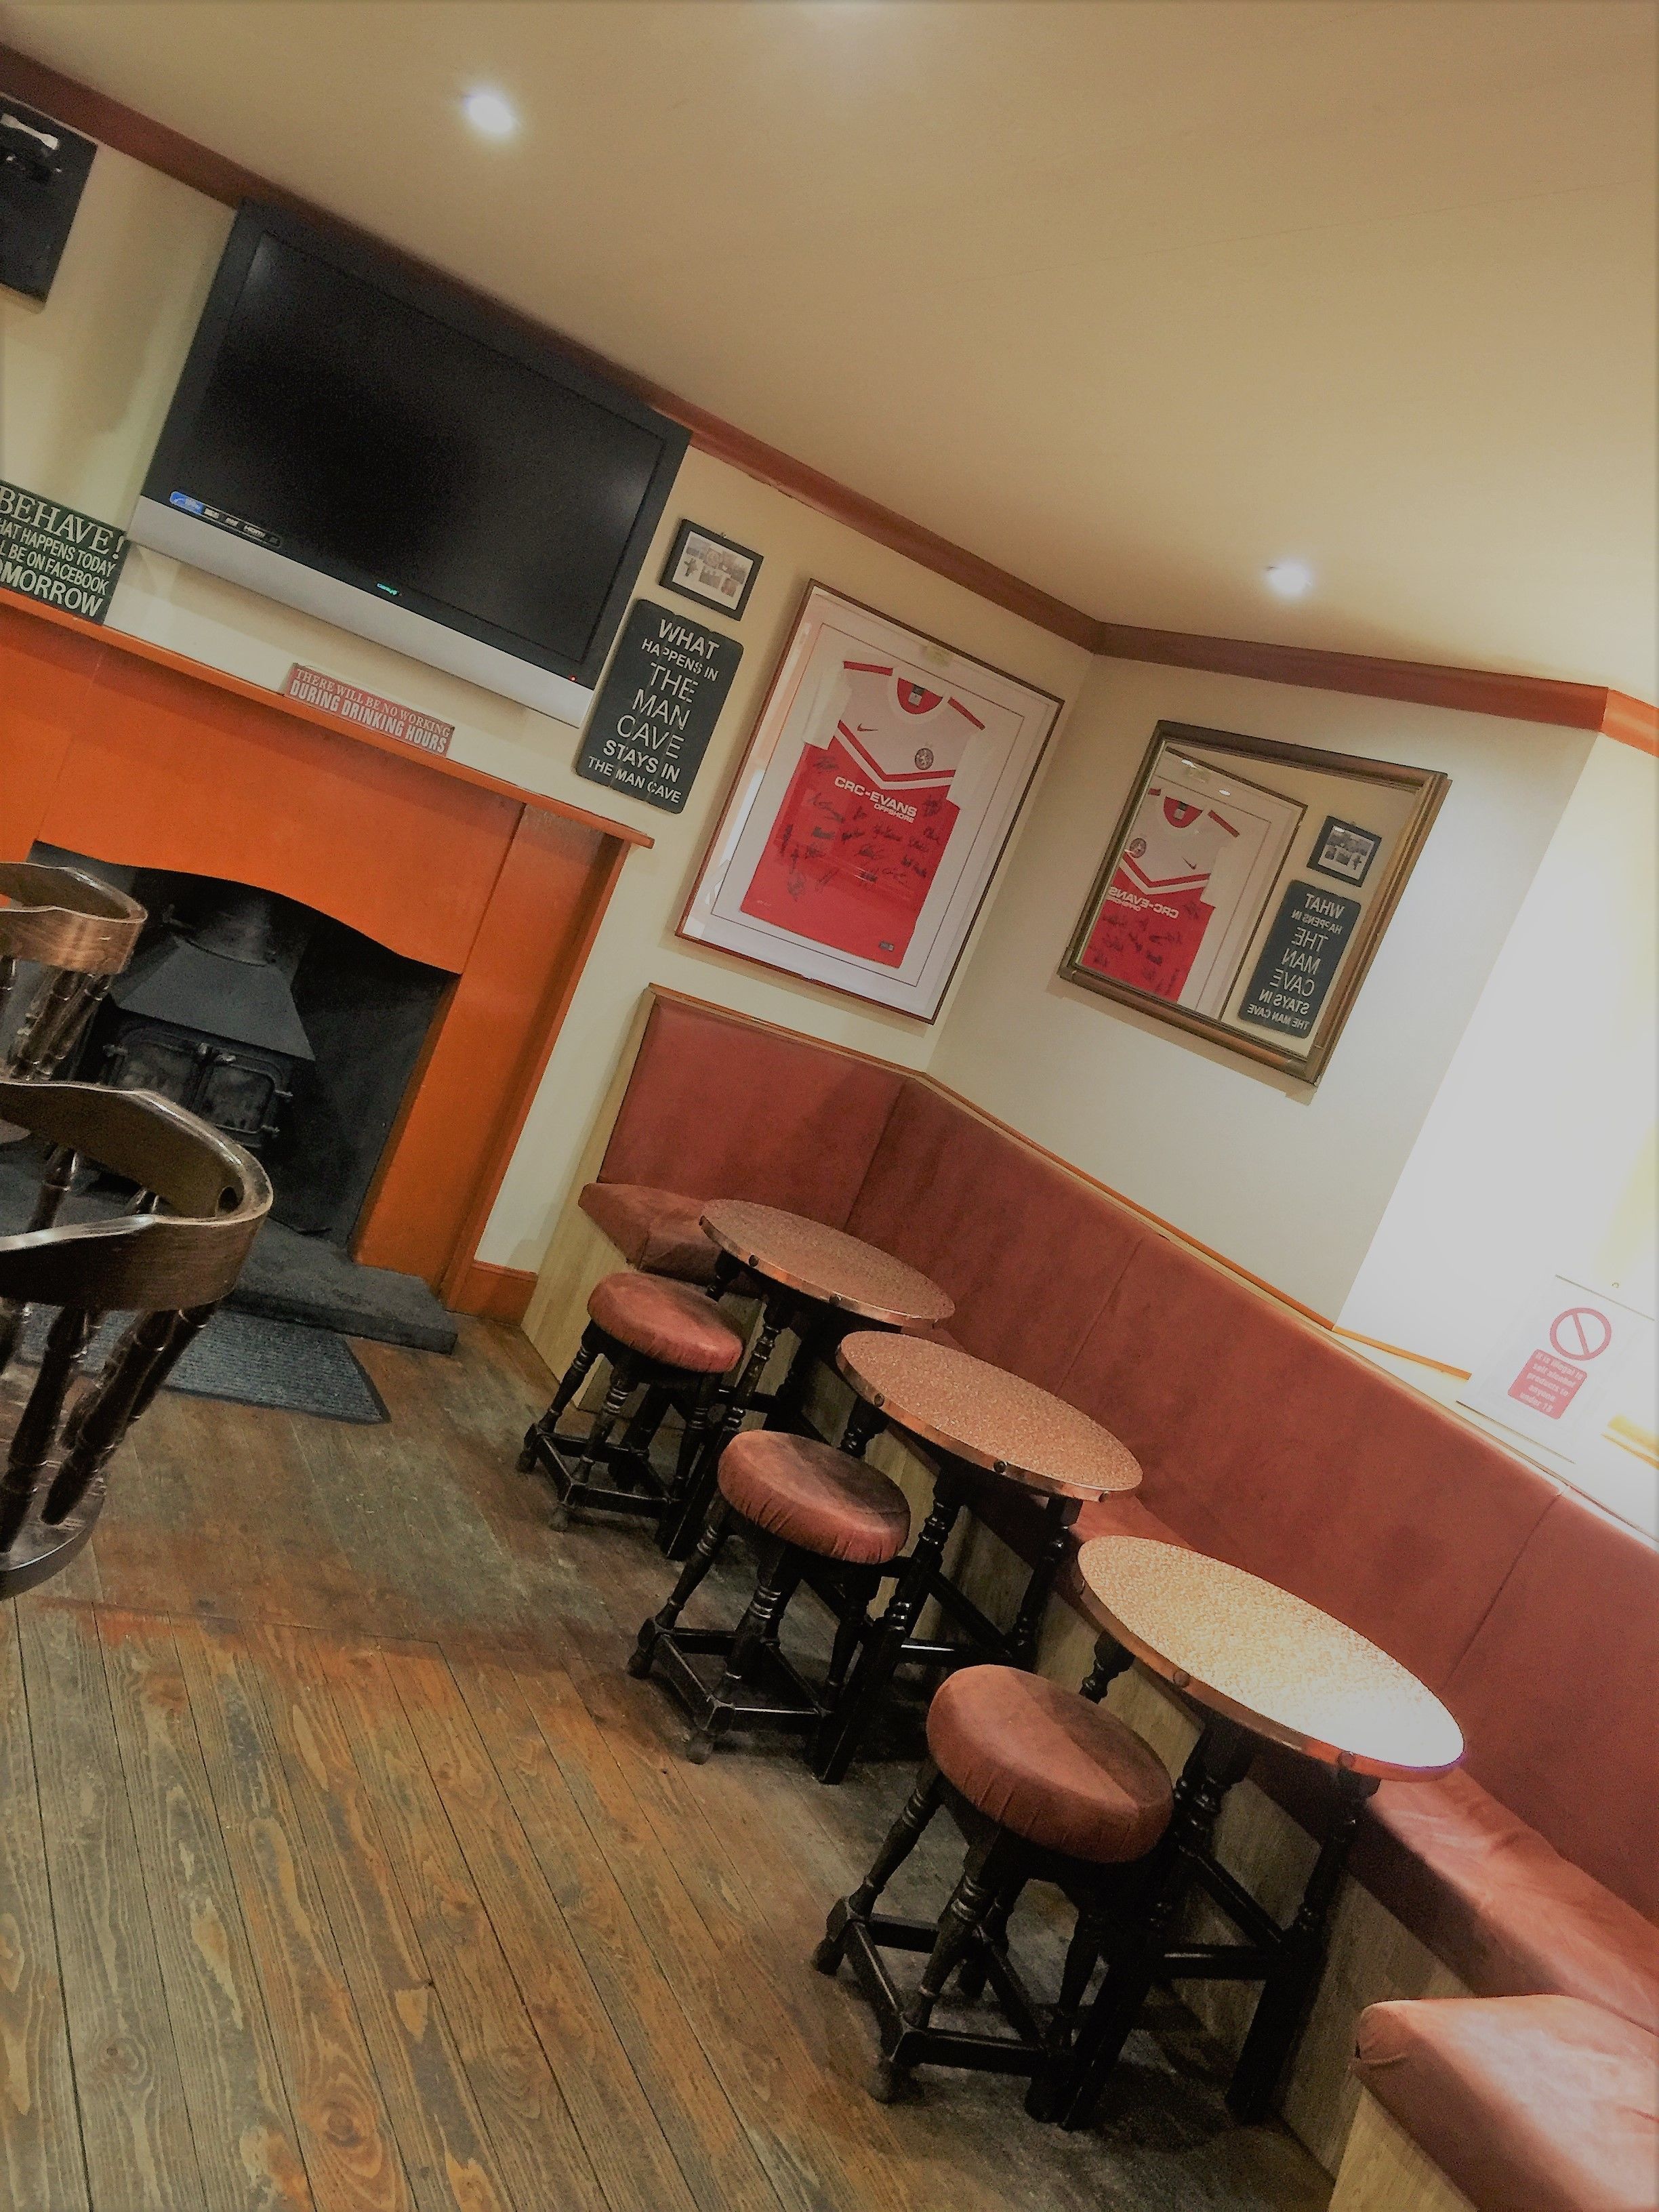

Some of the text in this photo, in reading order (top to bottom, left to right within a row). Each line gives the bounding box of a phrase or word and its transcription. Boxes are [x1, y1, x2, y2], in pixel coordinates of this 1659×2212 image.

[0, 485, 125, 560] BEHAVE!
[0, 518, 22, 539] HAT
[20, 527, 76, 562] HAPPENS
[76, 549, 116, 577] TODAY
[8, 544, 27, 563] BE
[27, 551, 45, 571] ON
[46, 558, 110, 596] FACEBOOK
[0, 560, 103, 617] MORROW
[641, 638, 719, 682] HAPPENS IN
[658, 619, 720, 660] WHAT
[296, 668, 451, 737] THERE WILL BE NO WORKING
[650, 661, 699, 703] THE
[290, 679, 447, 754] DURING DRINKING HOURS
[632, 689, 691, 731] MAN
[617, 714, 685, 760] CAVE
[588, 755, 682, 804] THE MAN CAVE
[603, 739, 681, 783] STAYS IN
[834, 776, 918, 817] CRC-EVANS
[874, 803, 915, 823] OFFSHORE
